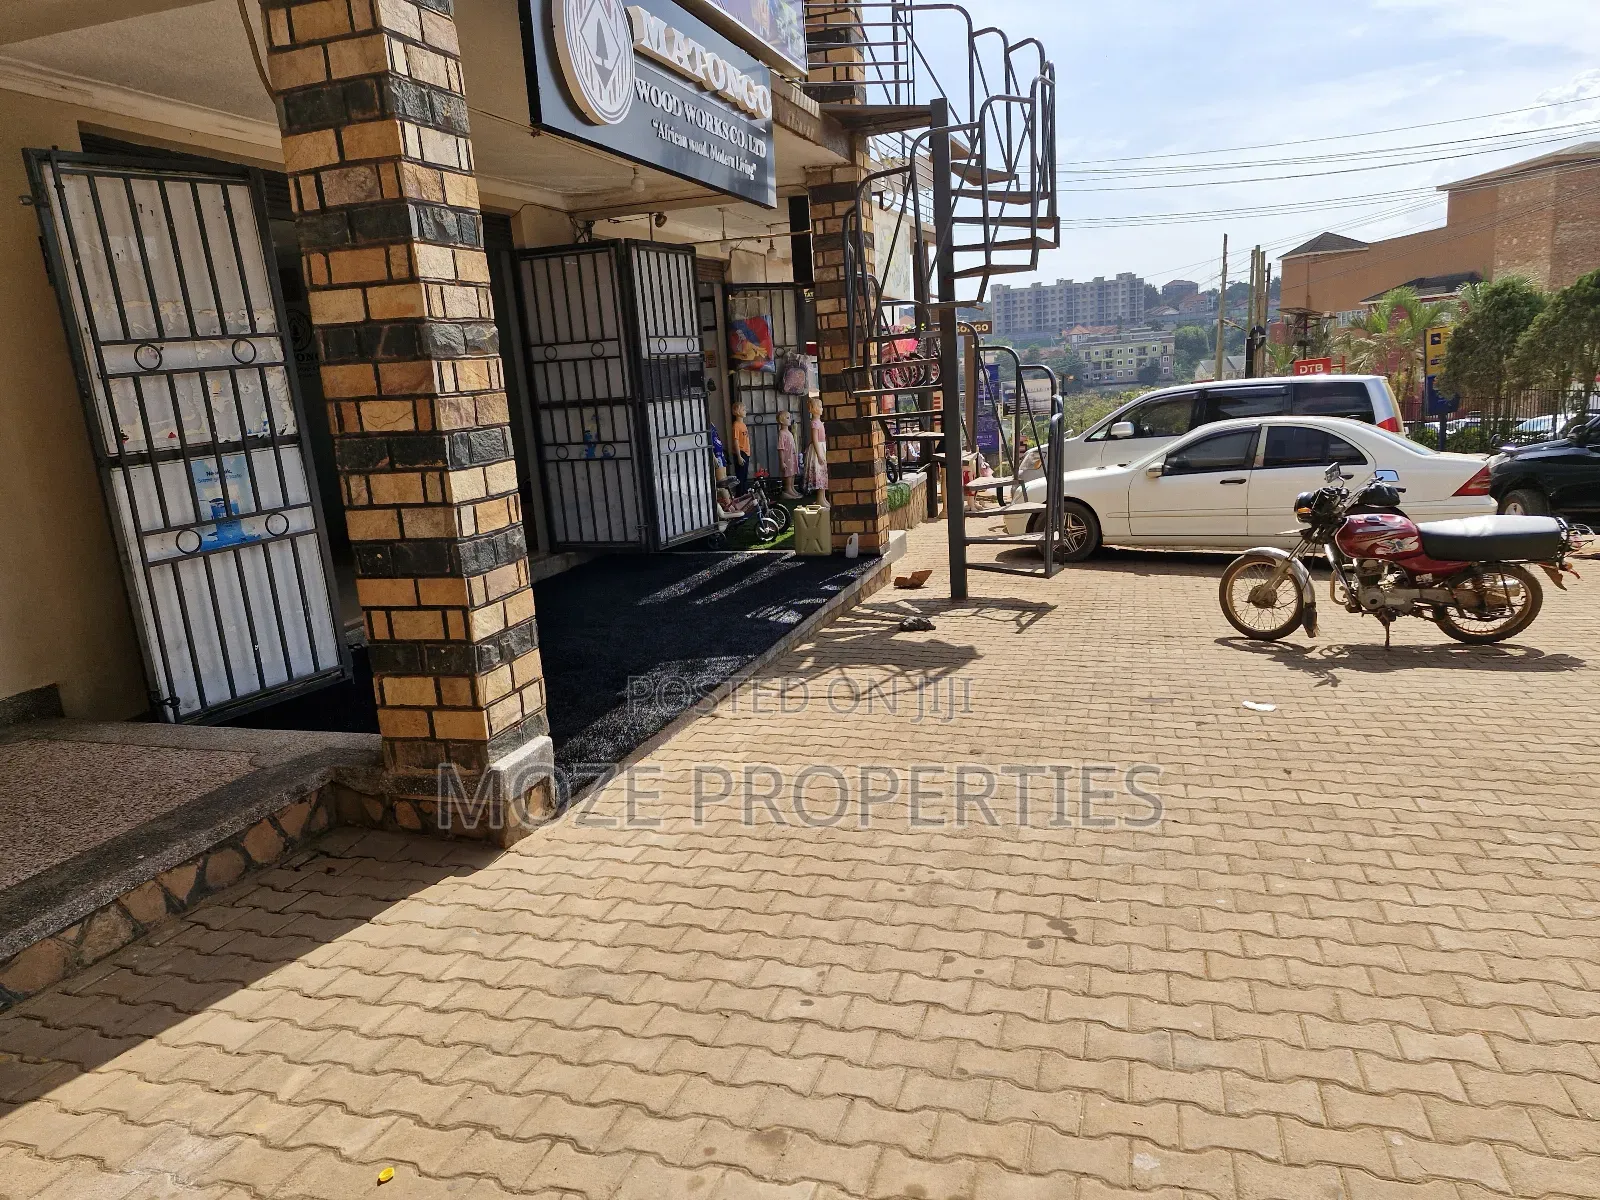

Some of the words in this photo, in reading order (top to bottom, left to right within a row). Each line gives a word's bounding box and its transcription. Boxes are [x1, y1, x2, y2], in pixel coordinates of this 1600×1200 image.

[626, 5, 772, 119] MATONGO
[634, 77, 682, 117] WOOD
[683, 101, 729, 141] WORKS
[747, 133, 767, 158] LTD
[709, 143, 736, 170] Modern
[1299, 363, 1324, 374] DTB
